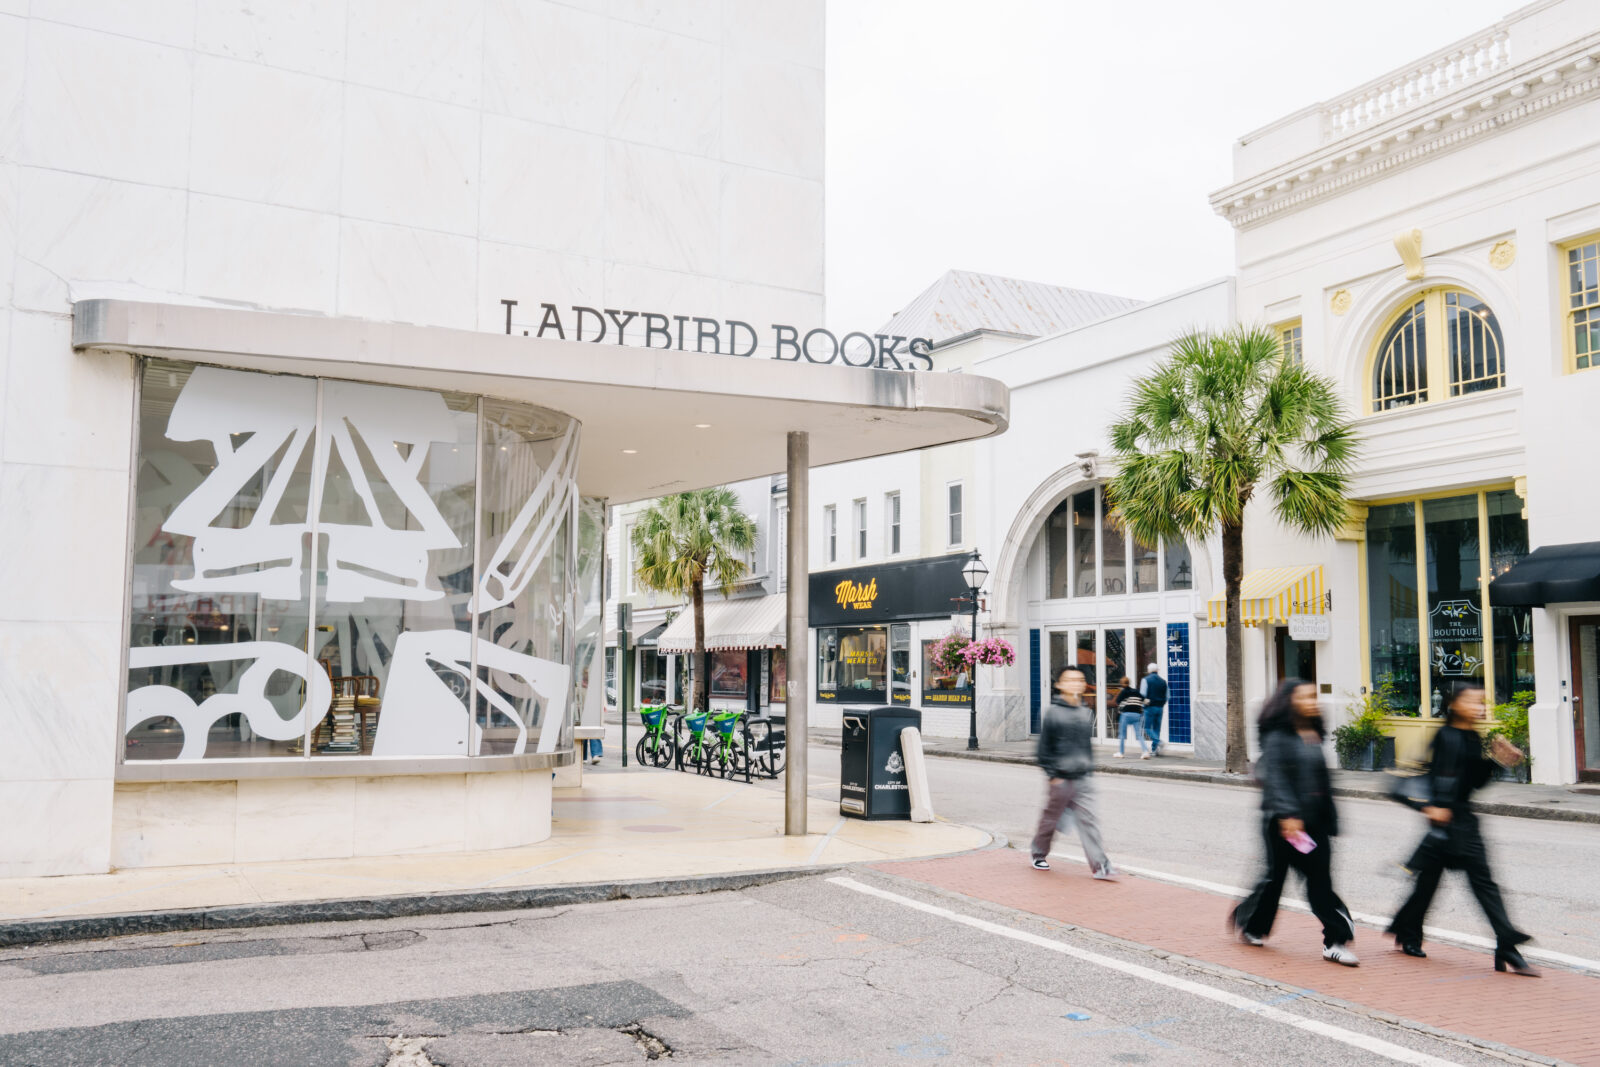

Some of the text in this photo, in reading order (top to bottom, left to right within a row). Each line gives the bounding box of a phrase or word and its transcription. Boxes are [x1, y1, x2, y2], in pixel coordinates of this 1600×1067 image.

[771, 324, 934, 372] BOOKS
[835, 577, 878, 610] Marsh
[853, 601, 872, 609] WEAR
[1434, 627, 1478, 637] BOUTIQUE
